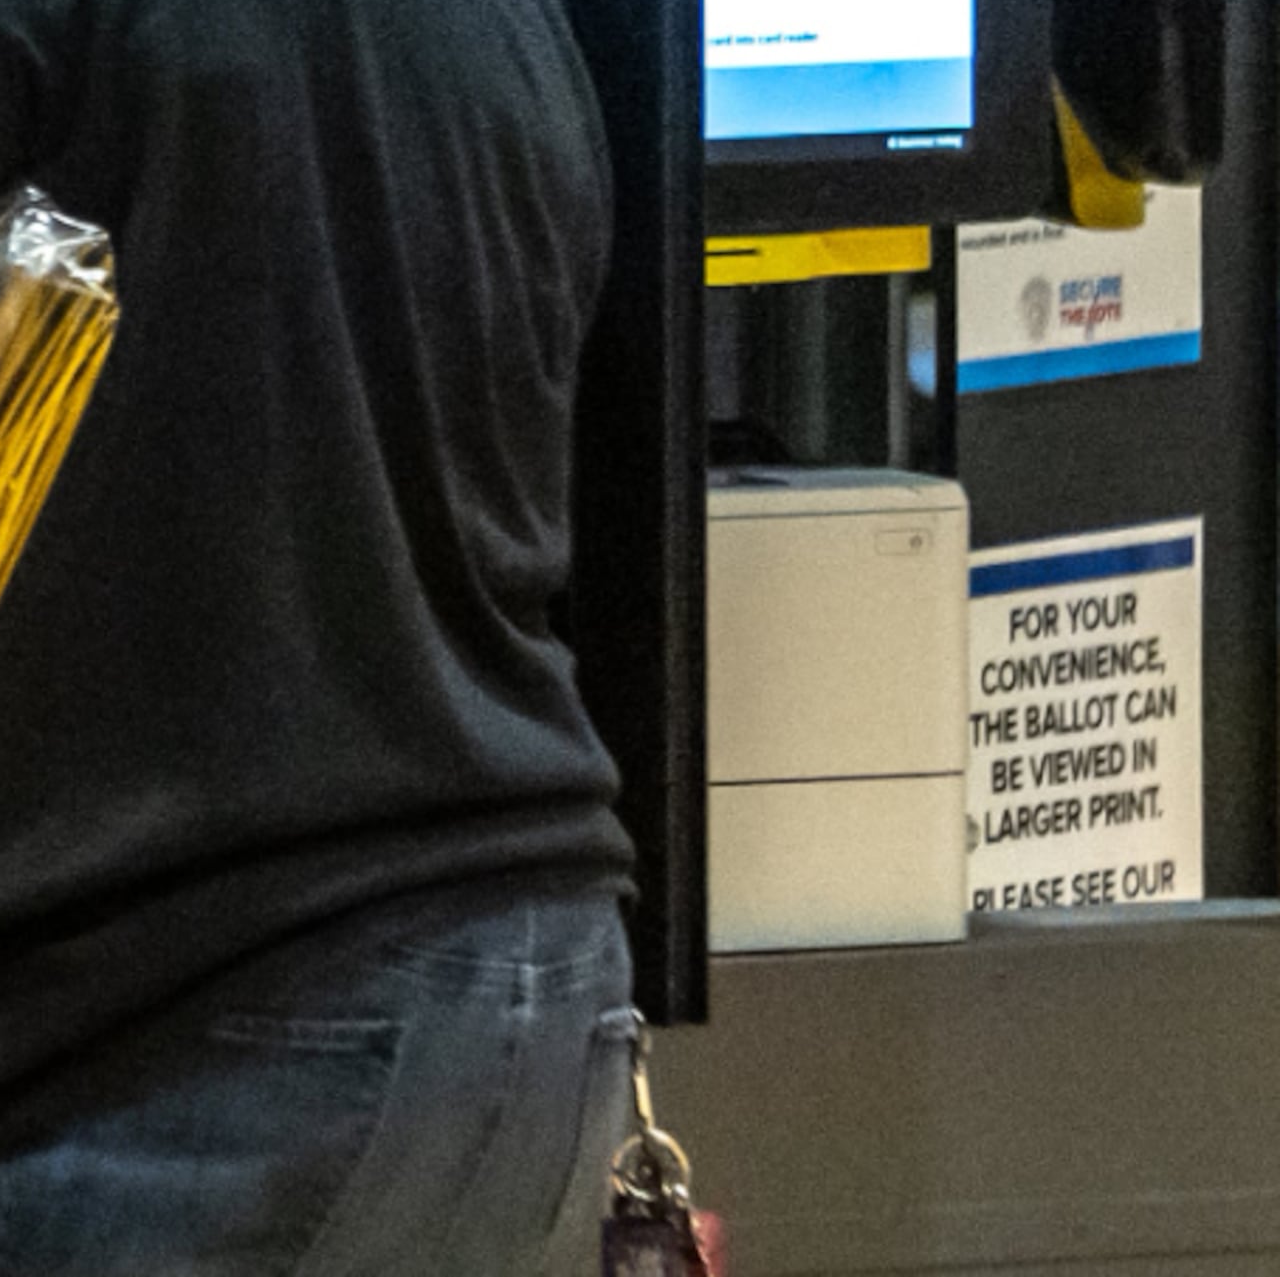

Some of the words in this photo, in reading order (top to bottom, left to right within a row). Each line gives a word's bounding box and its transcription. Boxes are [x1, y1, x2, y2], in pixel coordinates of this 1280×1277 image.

[1009, 601, 1058, 644] FOR
[1066, 591, 1137, 633] YOUR
[980, 636, 1166, 696] CONVENIENCE,
[970, 710, 1018, 748] THE
[1025, 692, 1120, 738] BALLOT
[1125, 685, 1177, 722] CAN
[991, 758, 1023, 795] BE
[1028, 745, 1125, 787] VIEWED
[1132, 737, 1157, 772] IN
[985, 796, 1082, 845] LARGER
[1088, 786, 1164, 828] PRINT.
[1071, 868, 1115, 906] SEE
[1122, 860, 1175, 899] OUR
